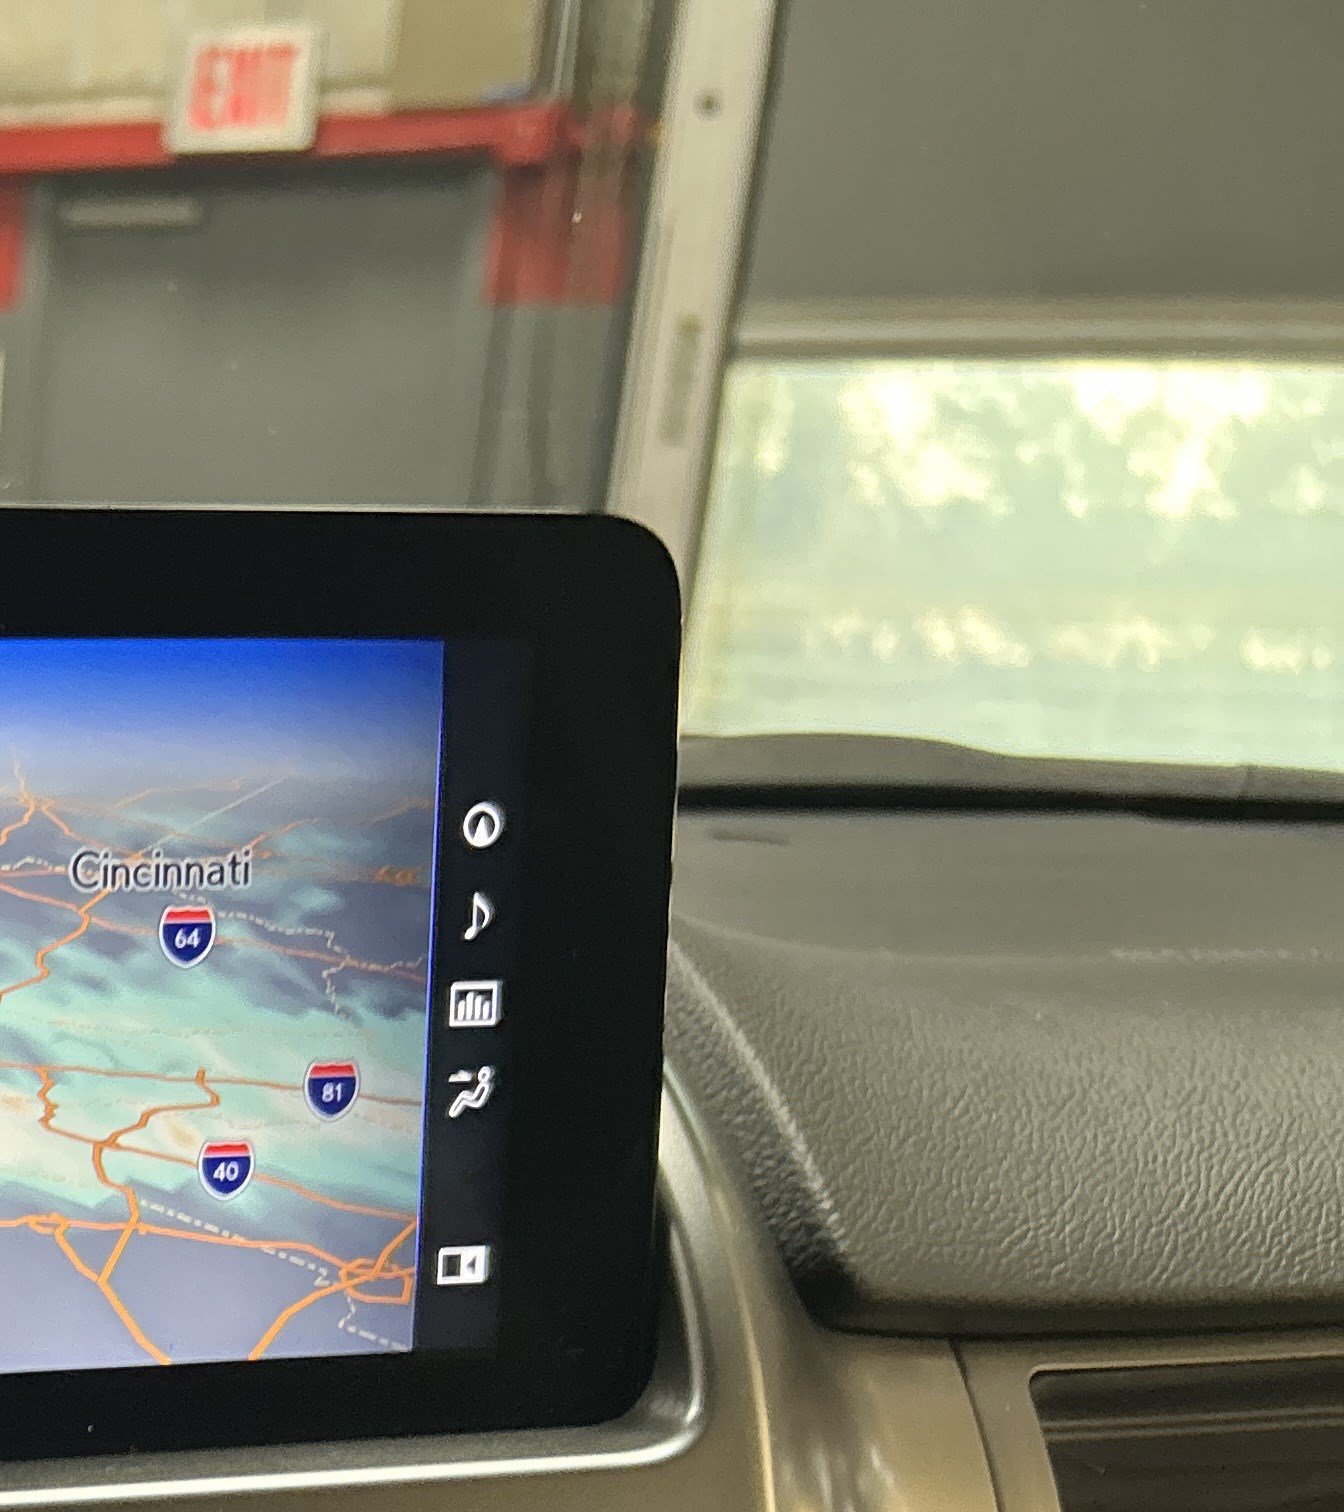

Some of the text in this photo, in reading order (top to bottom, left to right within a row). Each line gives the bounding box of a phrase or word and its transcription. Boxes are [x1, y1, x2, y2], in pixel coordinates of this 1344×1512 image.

[70, 850, 252, 890] Cincinnati
[175, 927, 200, 948] 64
[322, 1081, 344, 1102] 81
[212, 1161, 240, 1182] 40
